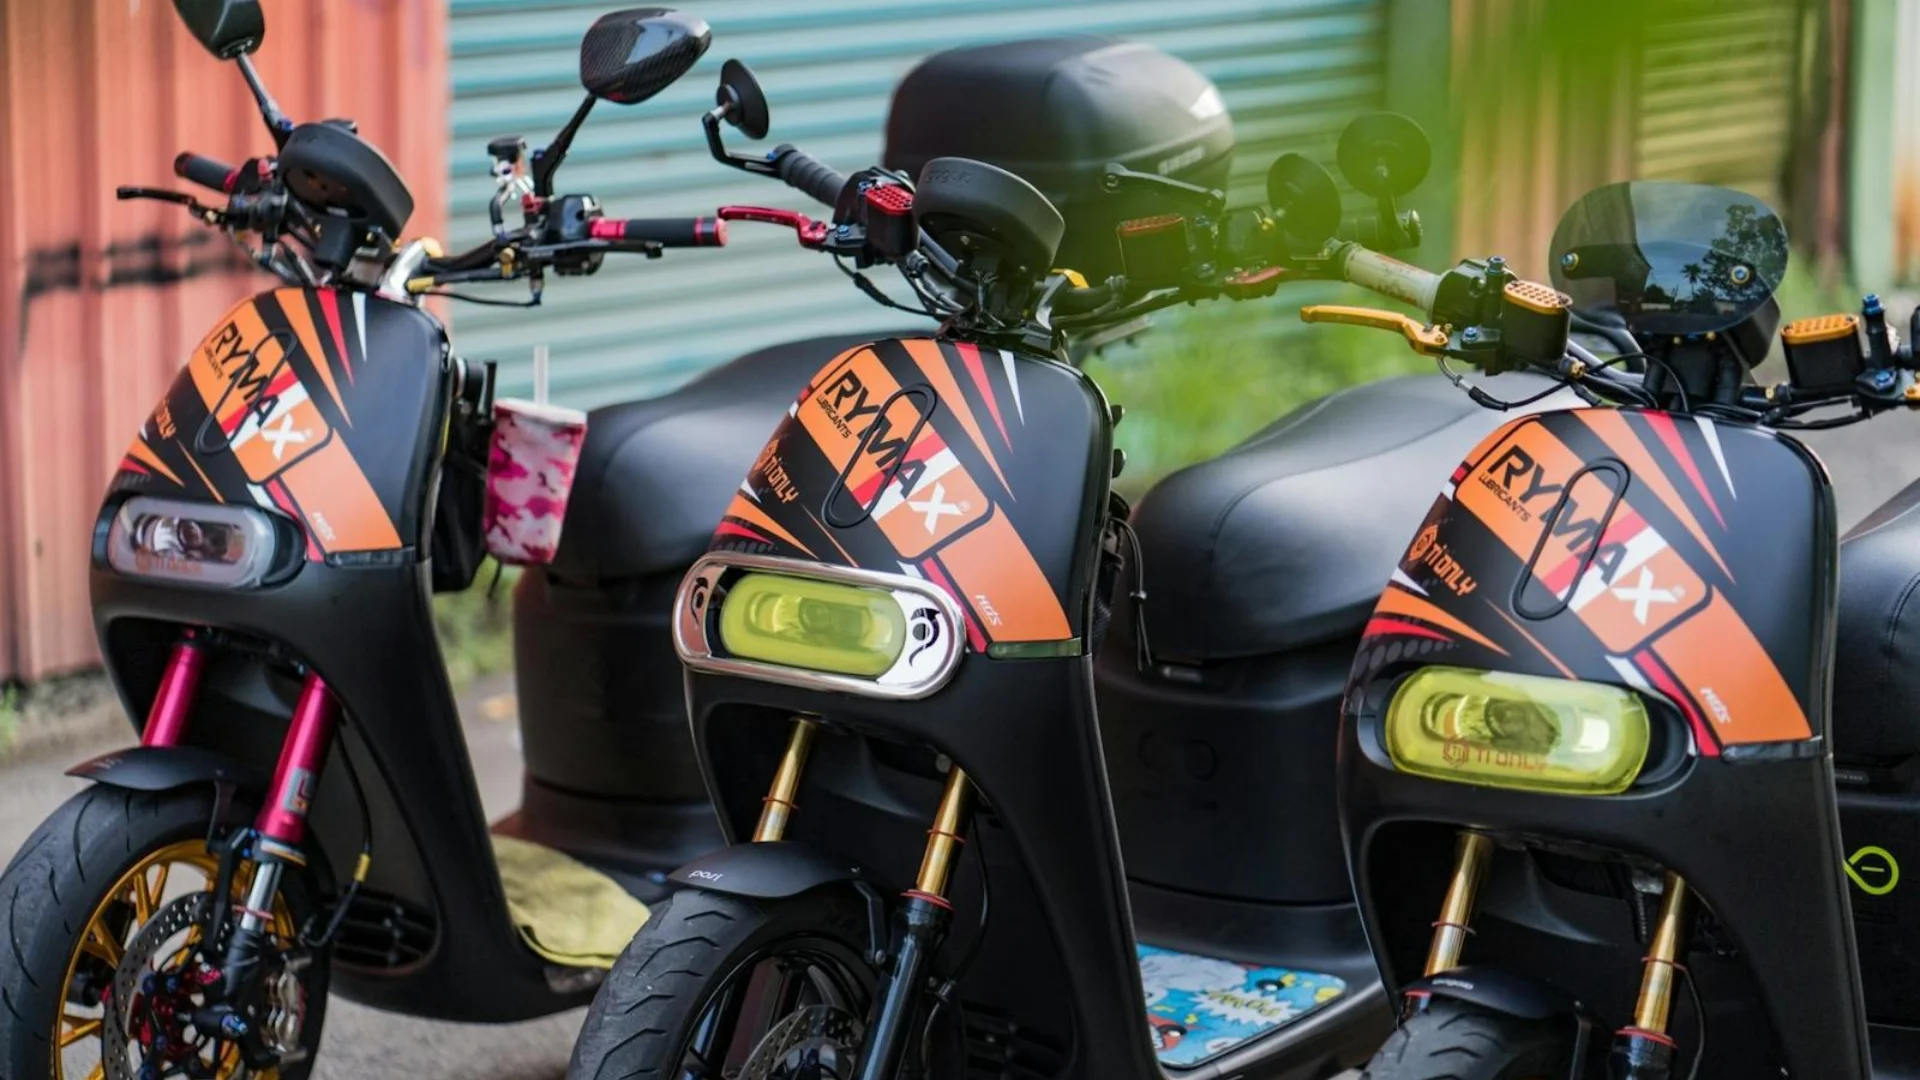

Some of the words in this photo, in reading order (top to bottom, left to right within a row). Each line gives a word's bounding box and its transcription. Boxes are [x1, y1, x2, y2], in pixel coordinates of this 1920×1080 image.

[816, 394, 852, 438] LUBRICANTS
[824, 369, 964, 535] RYMAX
[1478, 471, 1532, 522] LUBRICANTS
[1488, 444, 1680, 626] RYMAX
